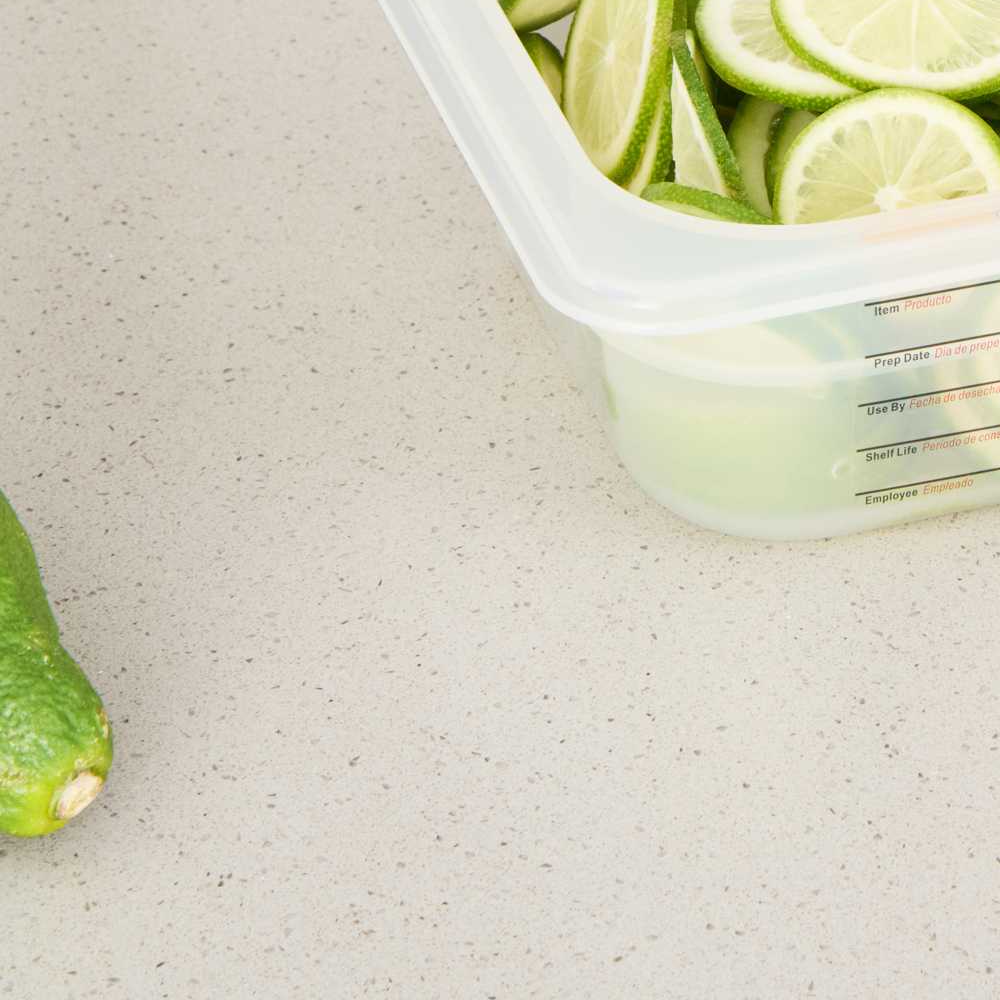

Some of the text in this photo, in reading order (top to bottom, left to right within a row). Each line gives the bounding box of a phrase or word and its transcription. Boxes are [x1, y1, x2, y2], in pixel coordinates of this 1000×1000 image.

[874, 294, 952, 316] Item Producto
[874, 355, 901, 369] Prep
[904, 350, 930, 363] Date
[954, 343, 967, 355] de
[867, 405, 888, 416] Use
[891, 402, 906, 412] By
[909, 396, 941, 409] Fecha
[943, 392, 956, 404] de
[866, 448, 894, 462] Shelf
[897, 445, 918, 457] Life
[963, 433, 976, 445] de
[865, 478, 974, 505] Employee Empleado
